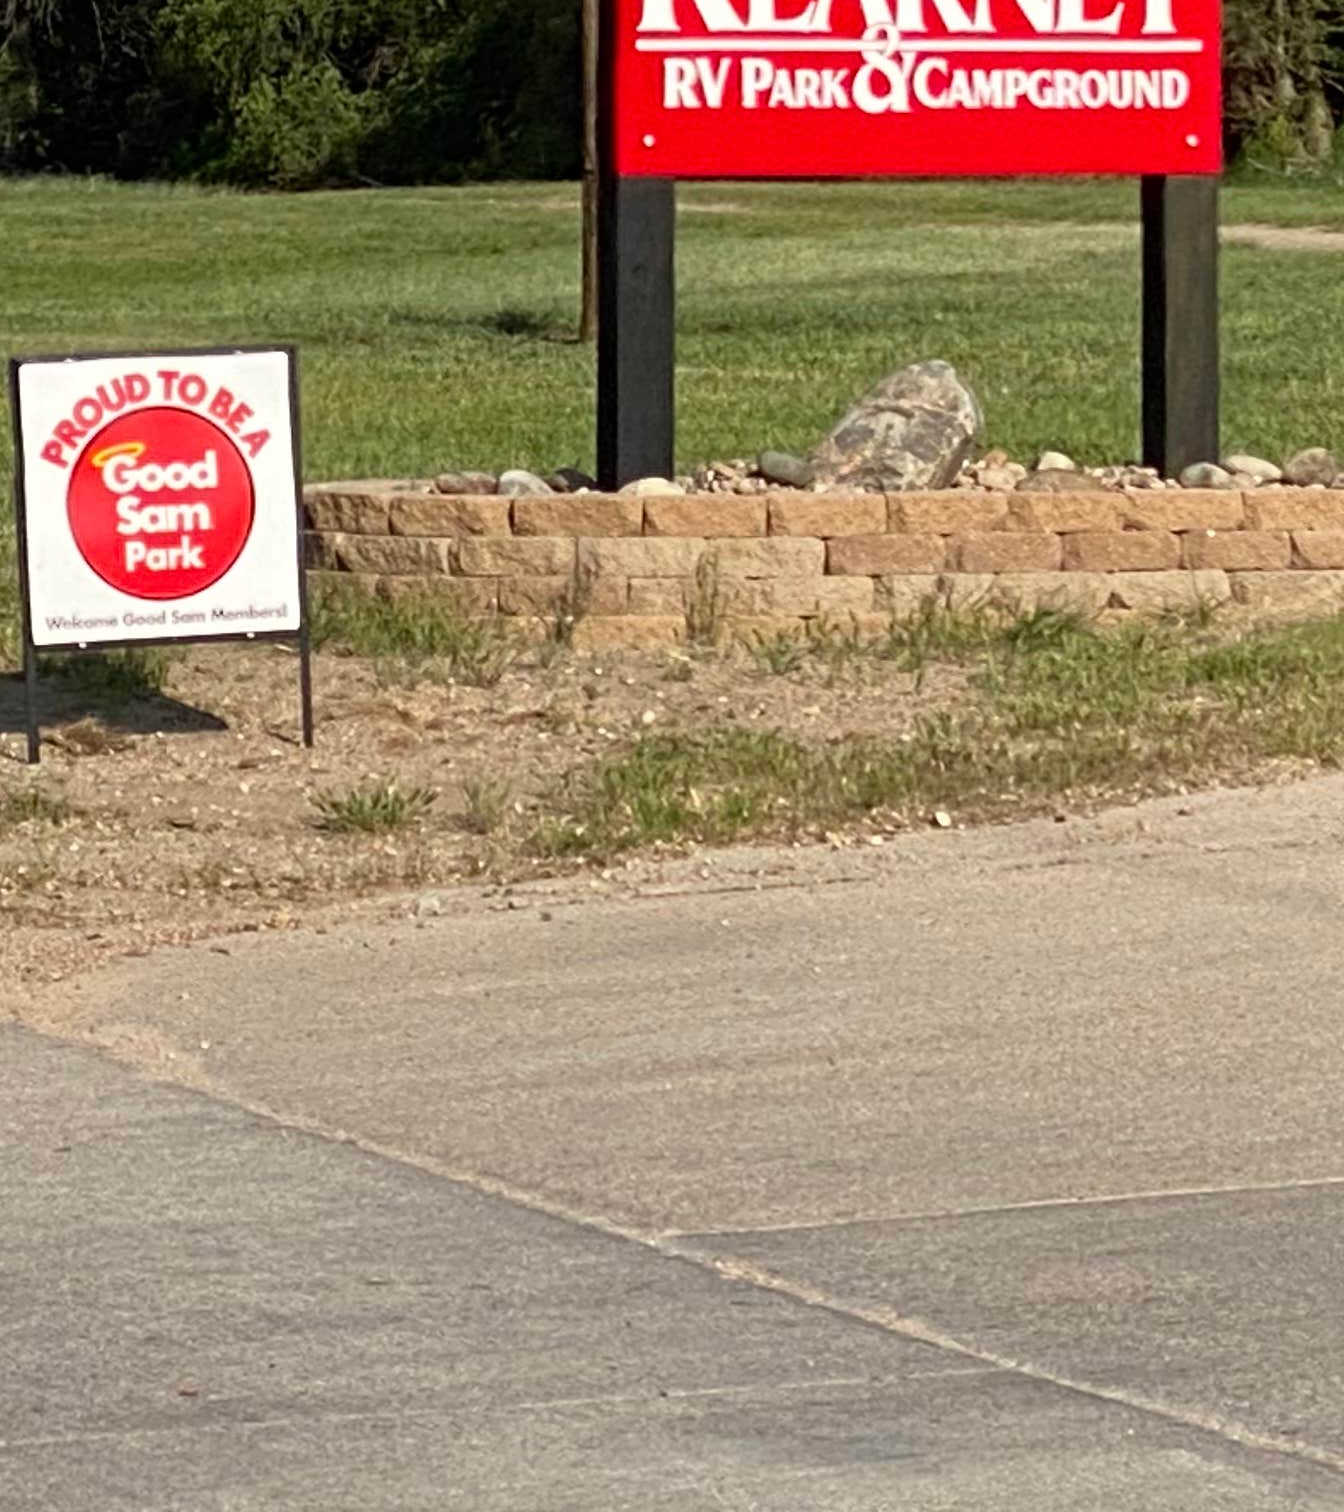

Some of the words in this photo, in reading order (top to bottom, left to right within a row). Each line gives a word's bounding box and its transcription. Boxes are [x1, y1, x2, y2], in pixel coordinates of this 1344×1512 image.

[663, 58, 732, 109] RV
[740, 58, 850, 109] PARK
[852, 23, 916, 114] &
[914, 58, 1189, 110] CAMPGROUND
[40, 373, 151, 468] PROUD
[157, 370, 208, 406] TO
[208, 386, 254, 433] BE
[240, 429, 271, 458] A
[102, 450, 218, 494] Good
[116, 496, 211, 535] Sam
[125, 536, 205, 572] Park
[46, 611, 118, 630] Welcome
[123, 608, 166, 626] Good
[172, 608, 206, 624] Sam
[211, 603, 288, 621] Members!
